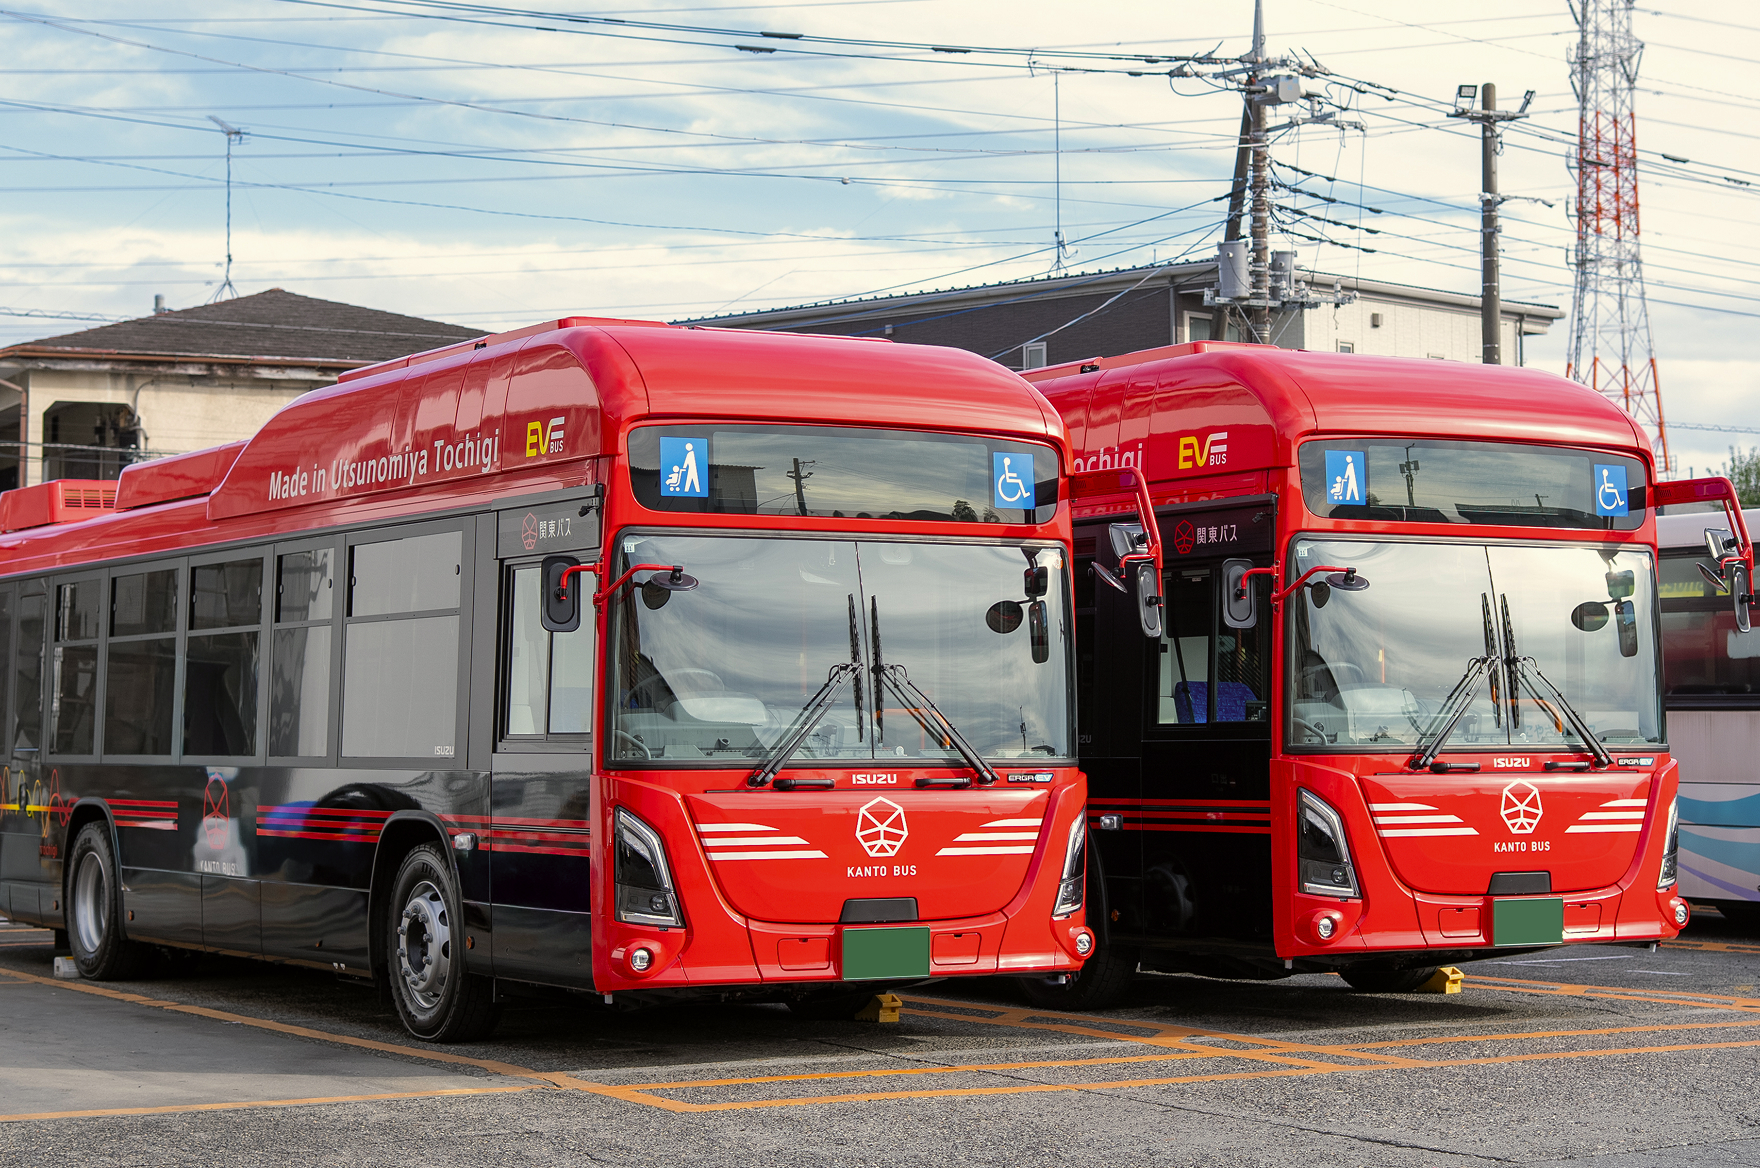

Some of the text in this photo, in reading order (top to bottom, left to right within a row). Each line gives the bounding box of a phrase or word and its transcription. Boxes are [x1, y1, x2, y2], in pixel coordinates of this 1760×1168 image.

[549, 441, 564, 453] BUS
[268, 429, 500, 501] Made in Utsunomiya Tochigi
[1209, 453, 1227, 466] BUS
[539, 517, 573, 540] 関東バス
[1196, 524, 1238, 545] 関東バス
[434, 745, 455, 755] ISUZU
[1493, 757, 1530, 768] ISUZU
[852, 773, 897, 785] ISUZU
[1494, 841, 1550, 852] KANTO BUS
[847, 864, 917, 877] KANTO BUS
